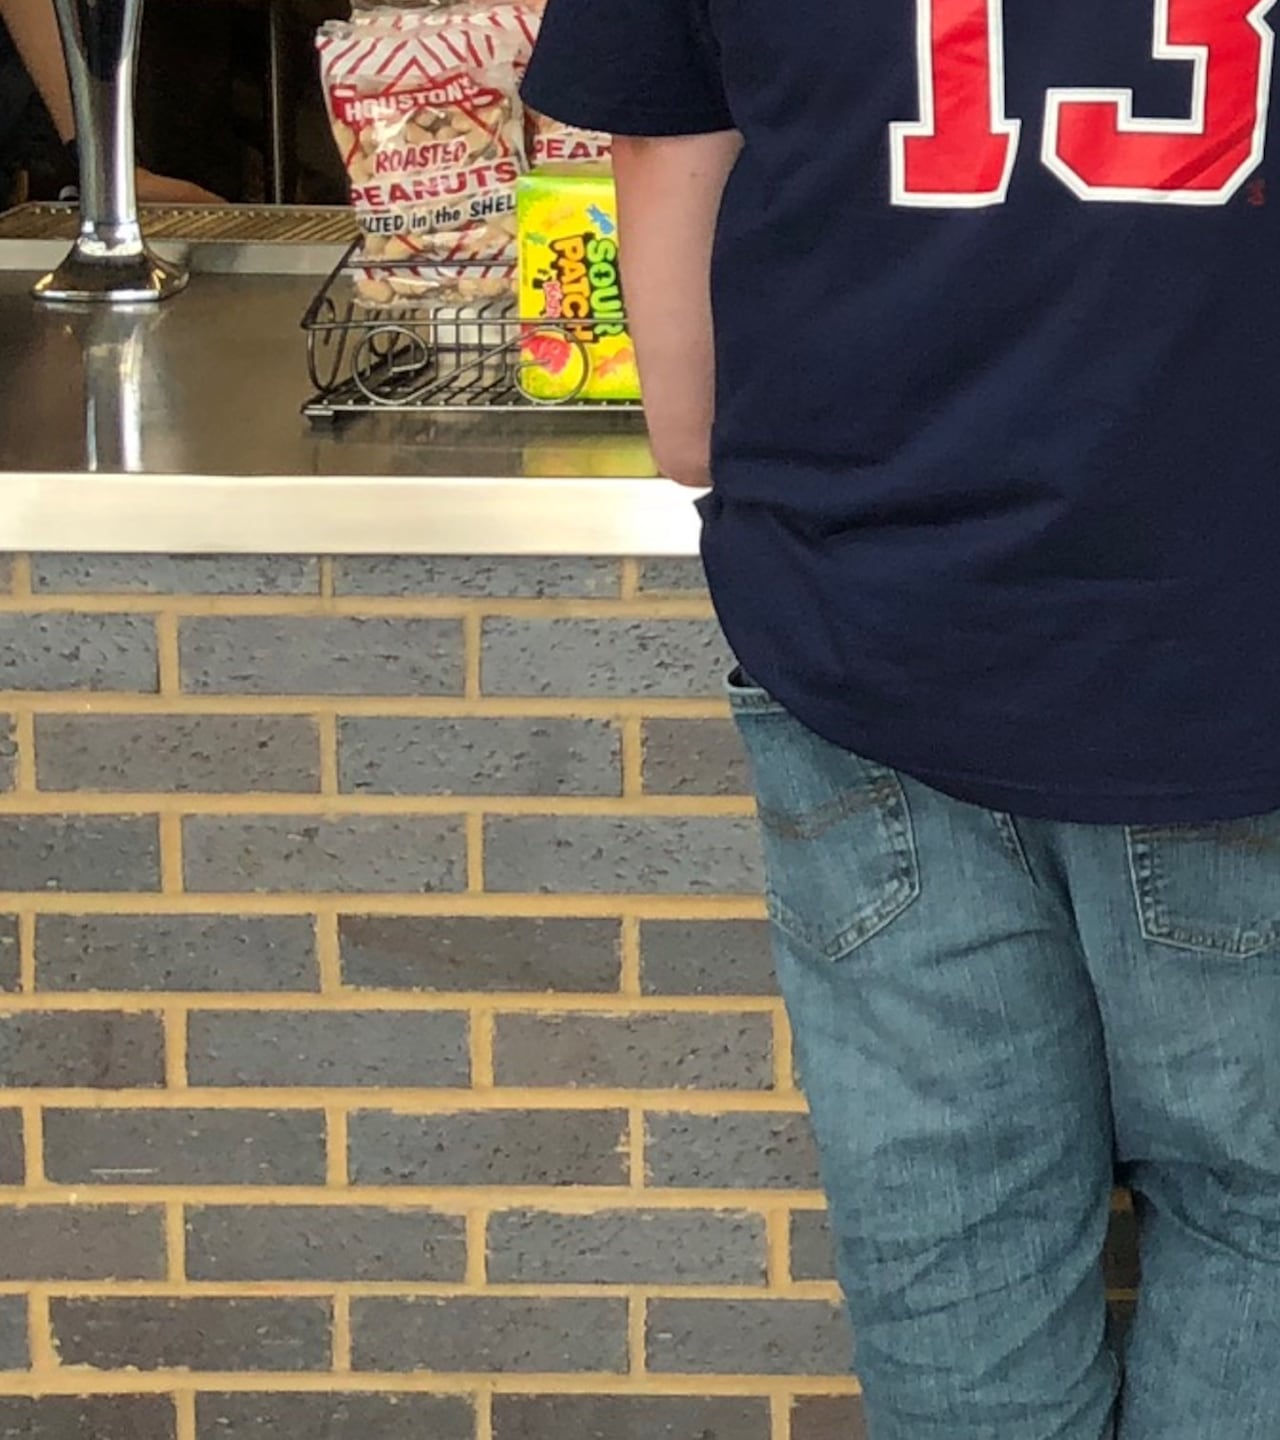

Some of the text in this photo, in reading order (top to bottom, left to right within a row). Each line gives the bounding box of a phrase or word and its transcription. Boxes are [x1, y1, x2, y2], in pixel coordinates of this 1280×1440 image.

[344, 75, 479, 122] HOUSTON'S
[375, 140, 467, 174] ROASTED
[349, 161, 518, 207] PEANUTS
[411, 213, 427, 229] in
[435, 206, 461, 225] the
[552, 235, 594, 343] PATCH
[587, 238, 626, 336] SOUR
